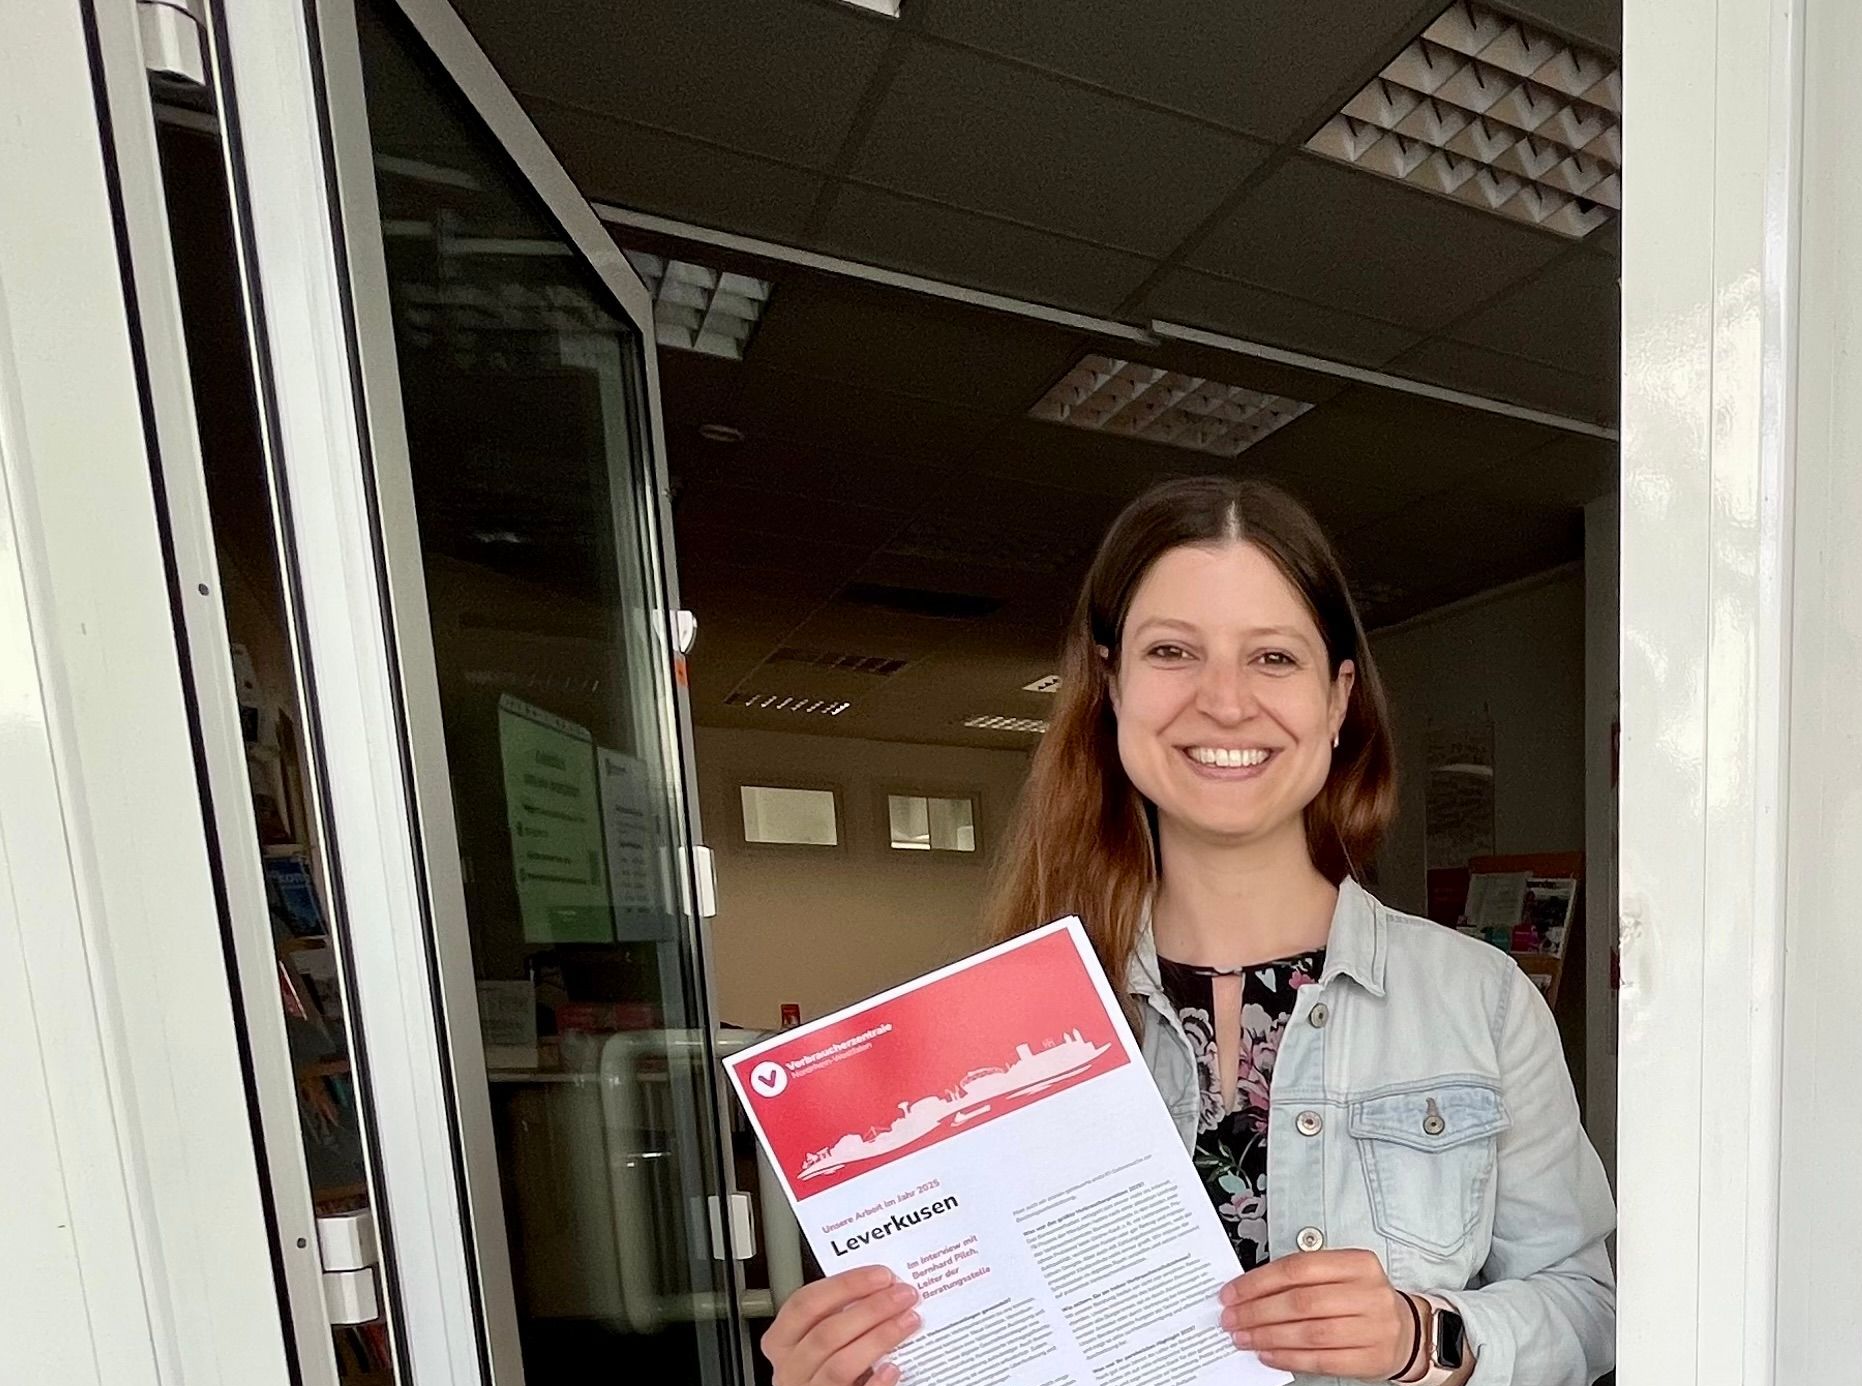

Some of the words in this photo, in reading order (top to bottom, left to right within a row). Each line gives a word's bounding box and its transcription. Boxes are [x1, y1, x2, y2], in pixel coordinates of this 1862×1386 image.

[784, 1022, 893, 1072] Verbraucherzentrale
[822, 1217, 854, 1235] Unsere
[855, 1204, 884, 1221] Arbeit
[897, 1189, 916, 1203] Jahr
[916, 1178, 941, 1195] 2025
[830, 1195, 959, 1257] Leverkusen
[920, 1243, 961, 1265] Interview
[963, 1234, 978, 1248] mit
[912, 1258, 953, 1280] Bernhard
[917, 1275, 943, 1290] Leiter
[945, 1266, 960, 1278] der
[922, 1265, 991, 1300] Beratungsstelle
